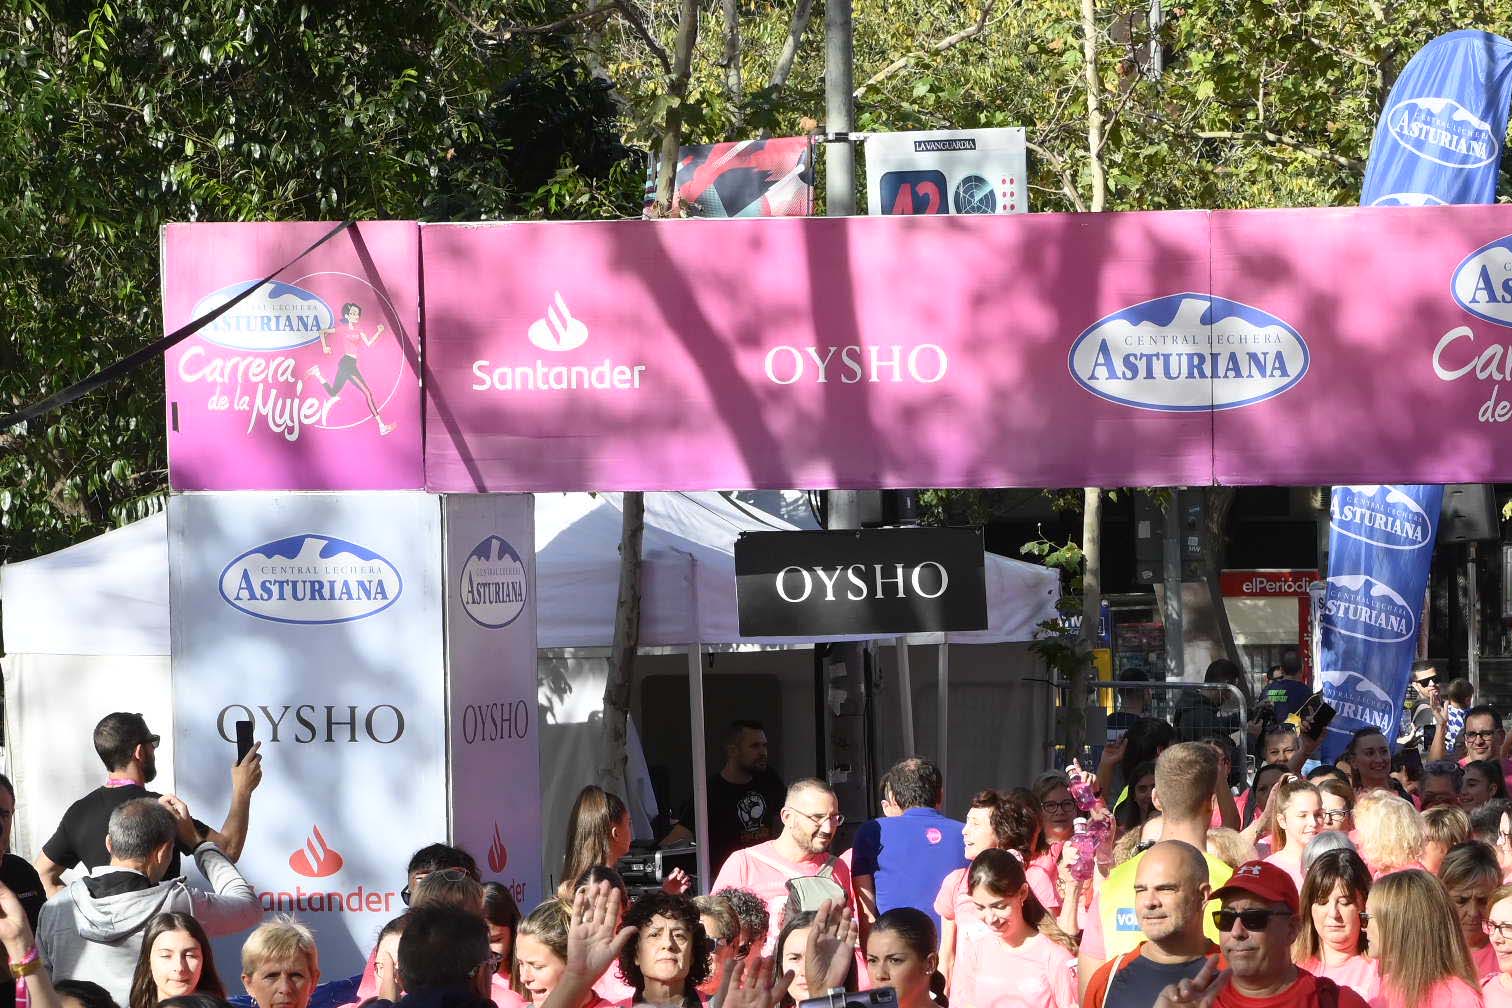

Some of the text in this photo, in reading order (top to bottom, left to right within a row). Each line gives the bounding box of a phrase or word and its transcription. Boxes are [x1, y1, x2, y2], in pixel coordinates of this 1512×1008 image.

[1124, 333, 1282, 346] CENTRAL LECHERA
[178, 345, 296, 384] Carrera
[472, 360, 646, 391] Santander
[765, 344, 949, 385] OYSHO
[1088, 342, 1290, 382] ASTURIANA
[208, 378, 341, 442] de la Mujer
[1478, 384, 1512, 423] de
[1330, 493, 1423, 543] ASTURIANA
[233, 568, 389, 602] ASTURIANA
[261, 565, 383, 576] CENTRAL LECHERA
[465, 569, 524, 606] ASTURIANA
[775, 561, 949, 604] OYSHO
[1325, 599, 1407, 635] STURIANA
[216, 703, 406, 745] OYSHO
[463, 700, 529, 745] OYSHO
[256, 885, 396, 914] antander
